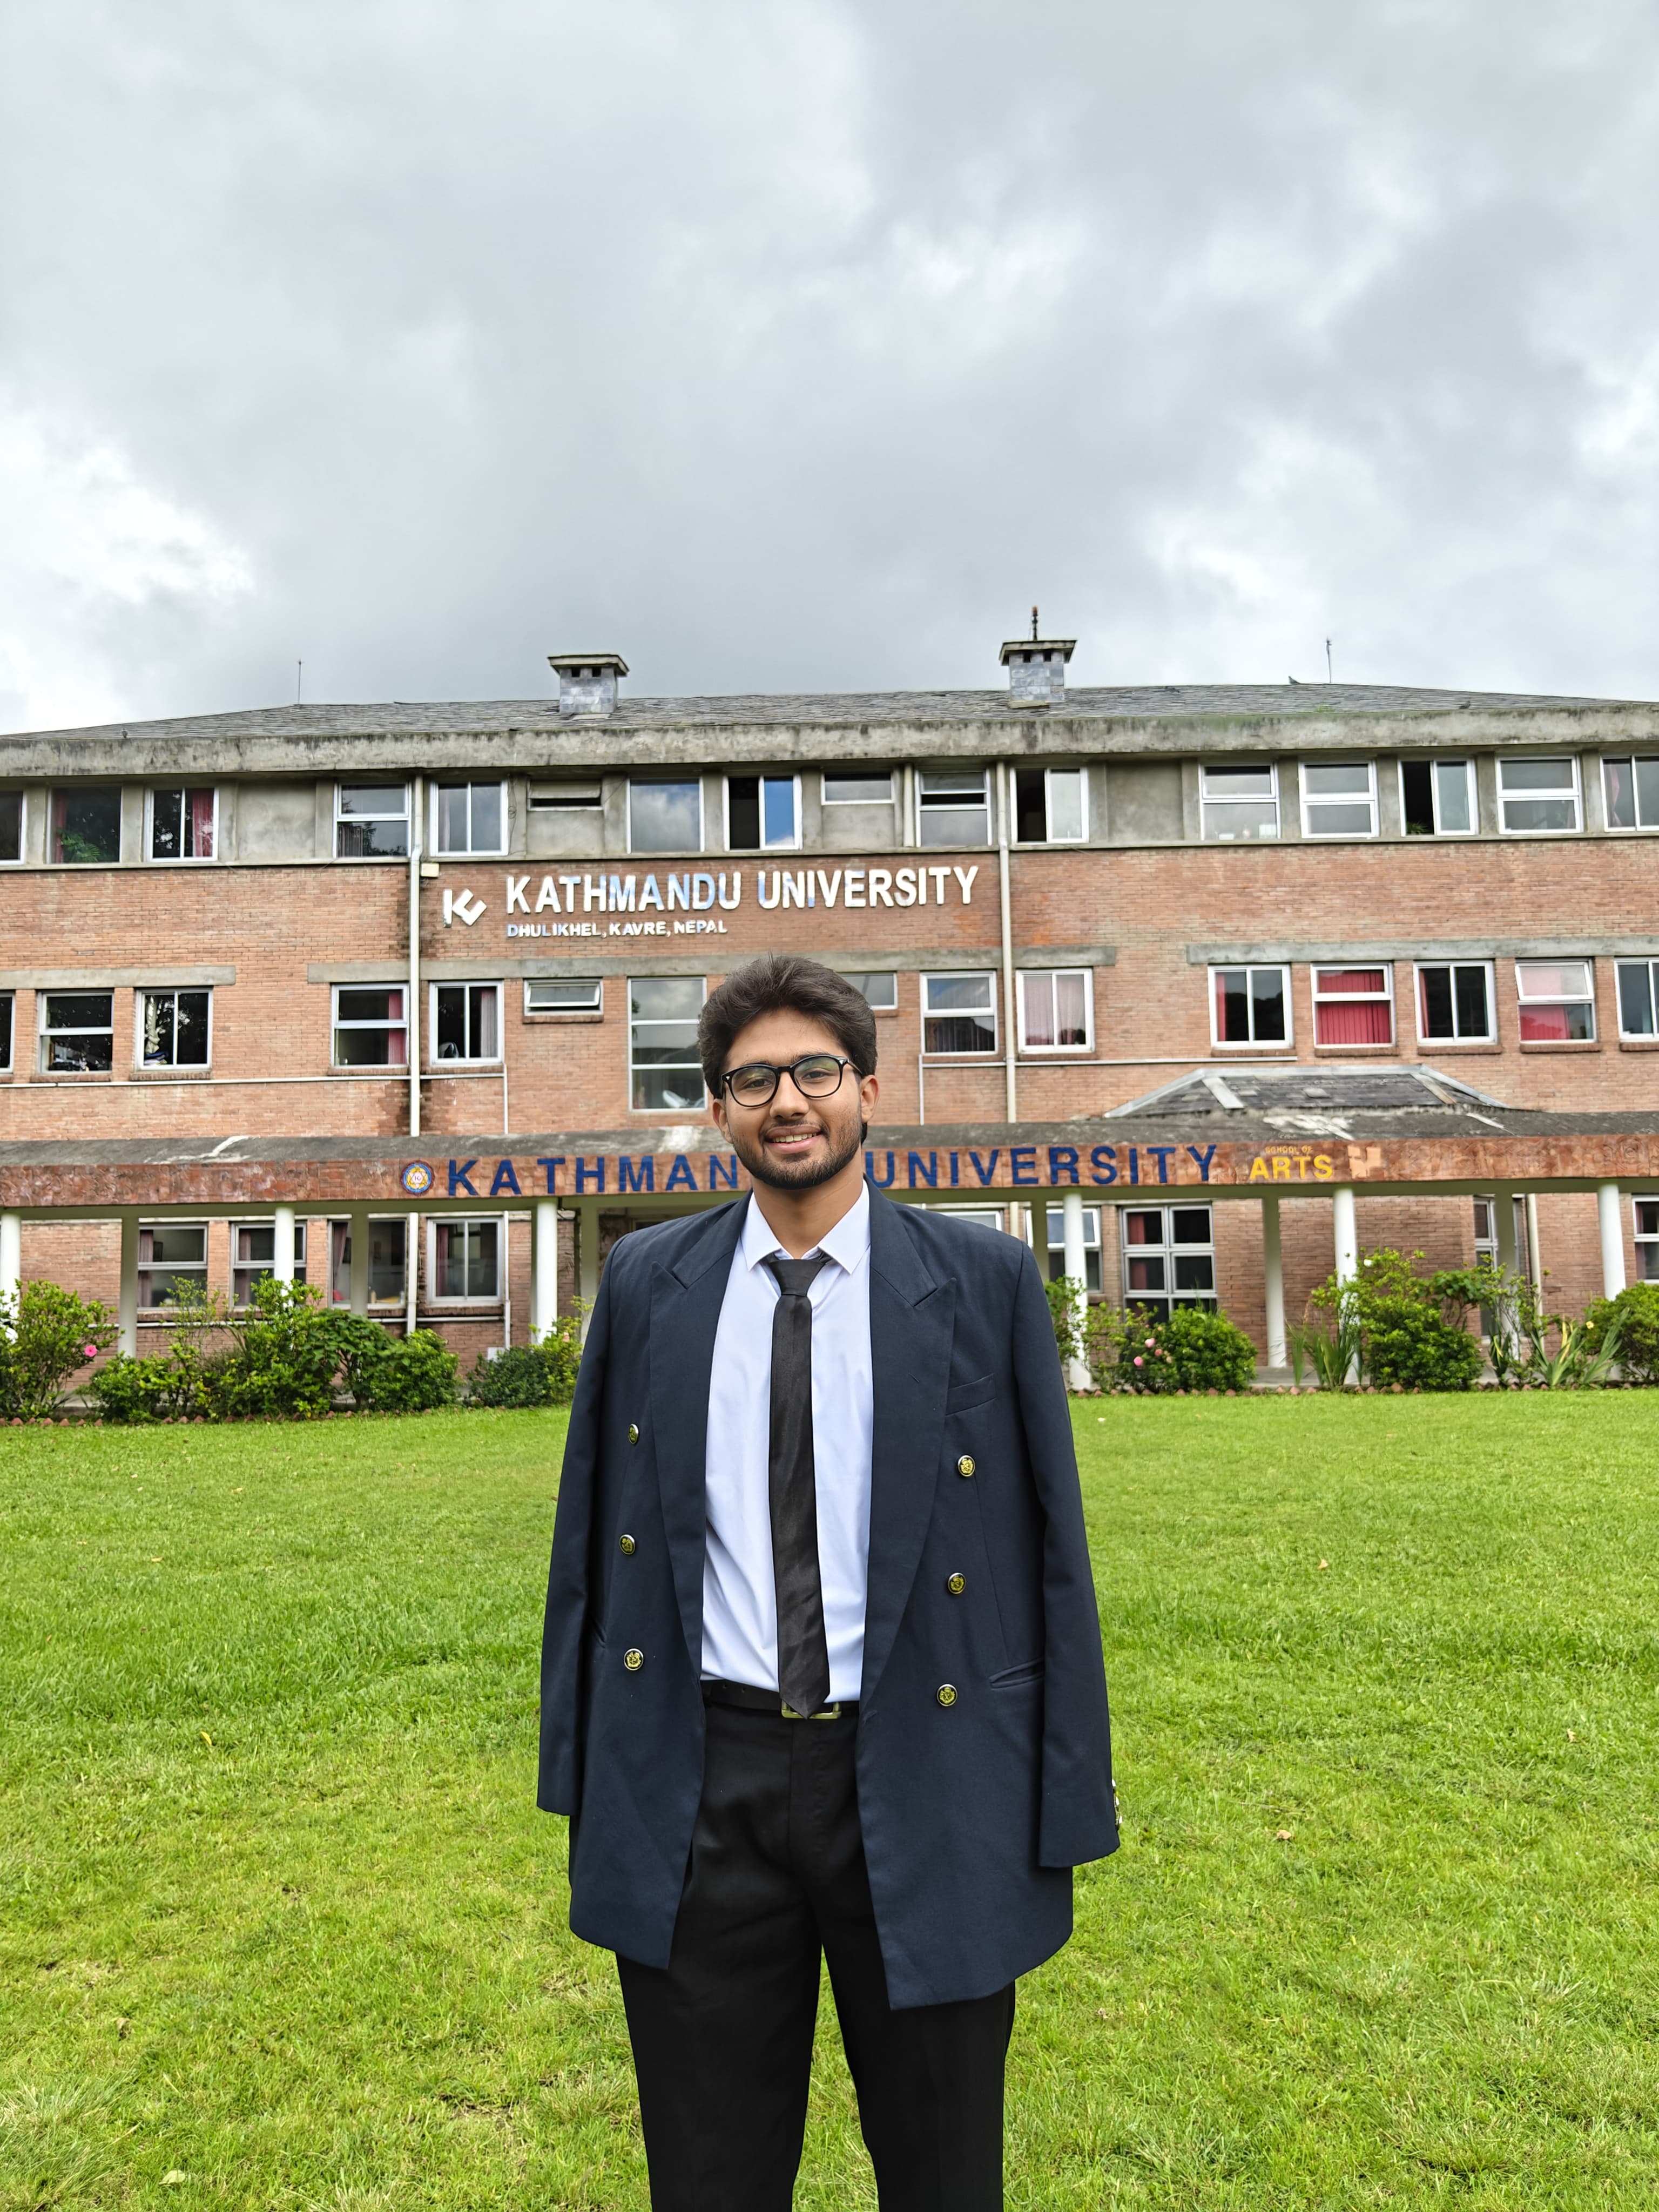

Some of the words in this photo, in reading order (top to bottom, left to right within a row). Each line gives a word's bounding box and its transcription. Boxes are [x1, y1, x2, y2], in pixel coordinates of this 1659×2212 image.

[507, 871, 741, 914] KATHMANDU
[758, 866, 979, 909] UNIVERSITY
[507, 922, 606, 938] DHULIKHEL,
[609, 921, 671, 938] KAVRE,
[673, 919, 728, 934] NEPAL
[1265, 1145, 1299, 1154] SCHOOL
[1301, 1145, 1313, 1154] OF
[448, 1154, 738, 1196] KATHMAN
[865, 1144, 1217, 1189] UNIVERSITY
[1249, 1155, 1333, 1180] ARTS
